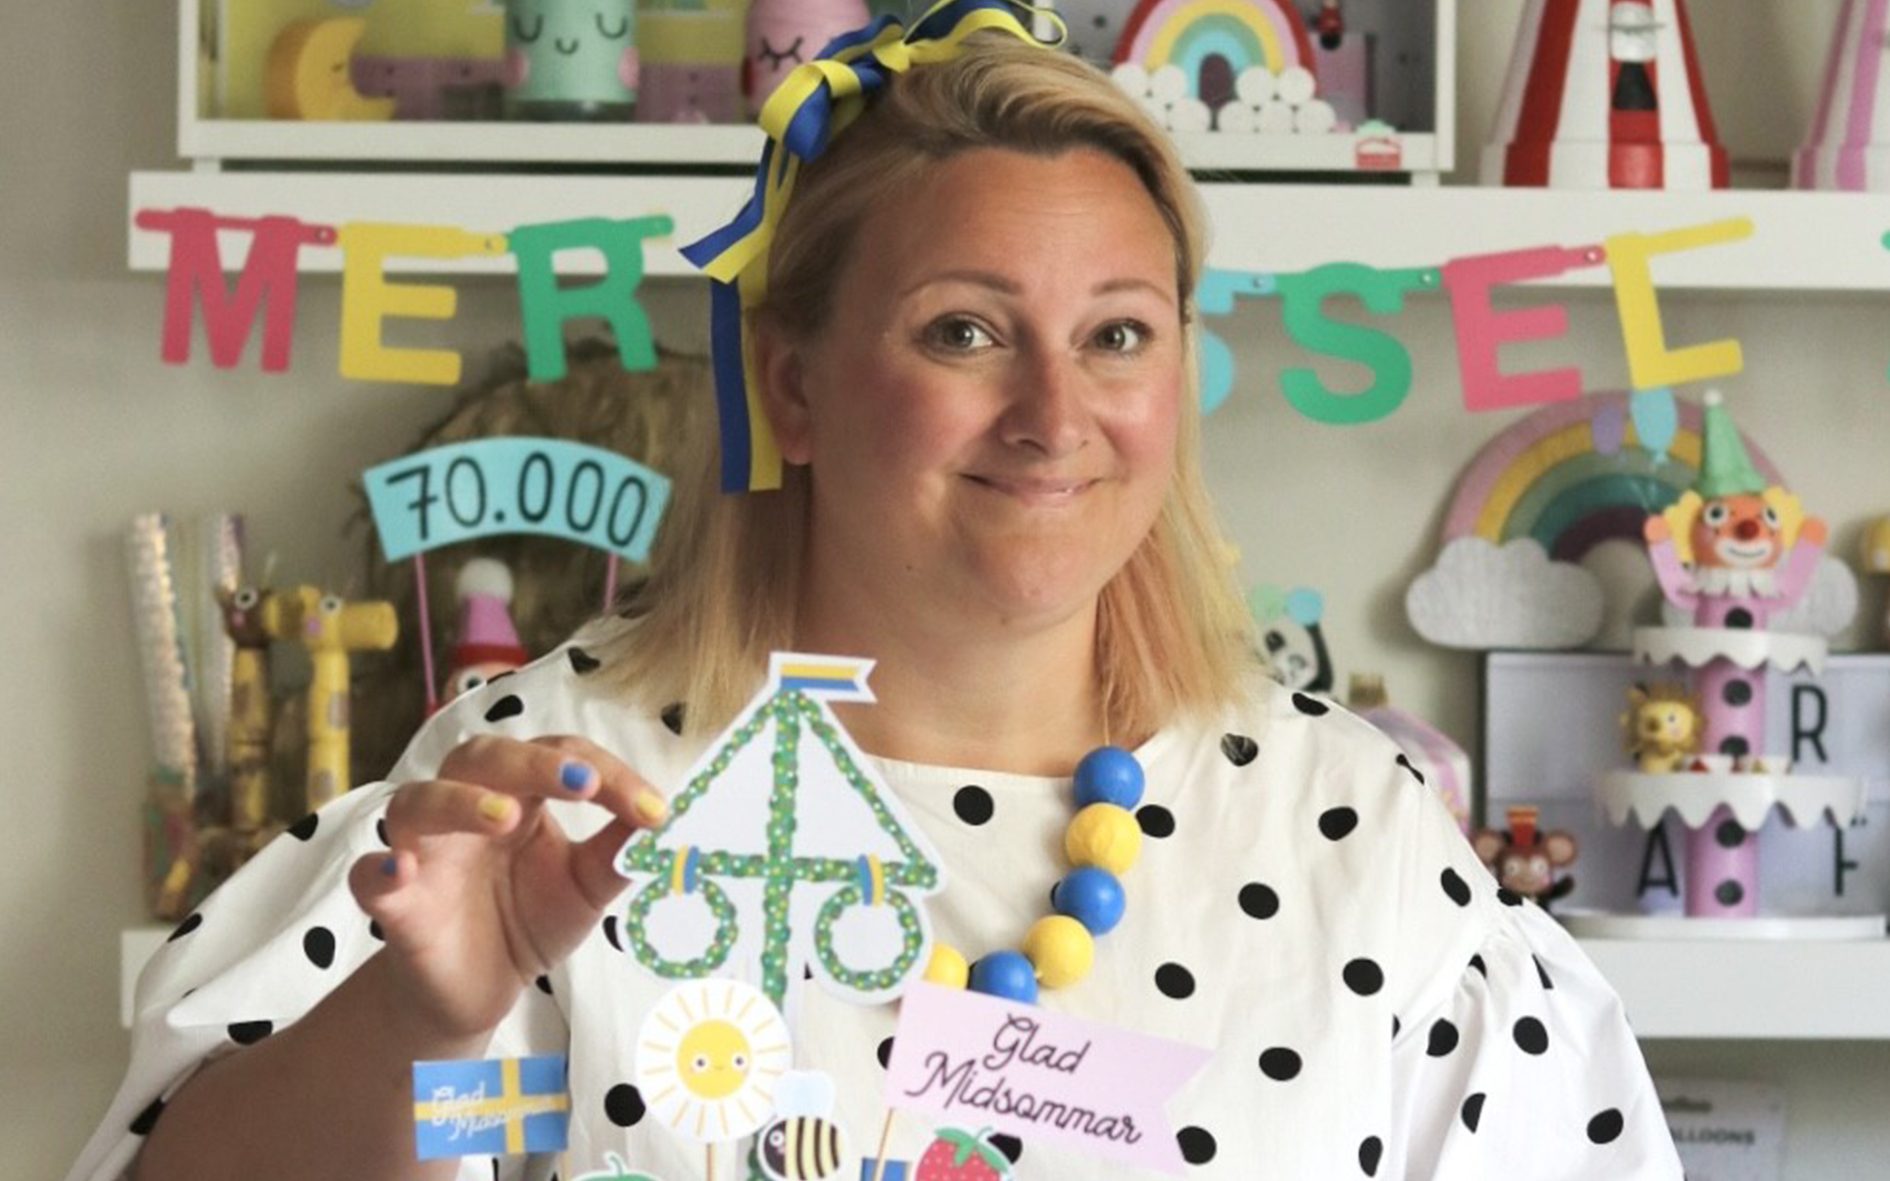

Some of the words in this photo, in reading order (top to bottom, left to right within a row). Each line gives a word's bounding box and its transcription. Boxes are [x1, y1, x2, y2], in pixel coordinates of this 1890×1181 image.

[138, 208, 672, 385] MER
[385, 451, 647, 548] 70.000
[981, 1012, 1092, 1072] Glad
[903, 1050, 1143, 1145] Midsommar
